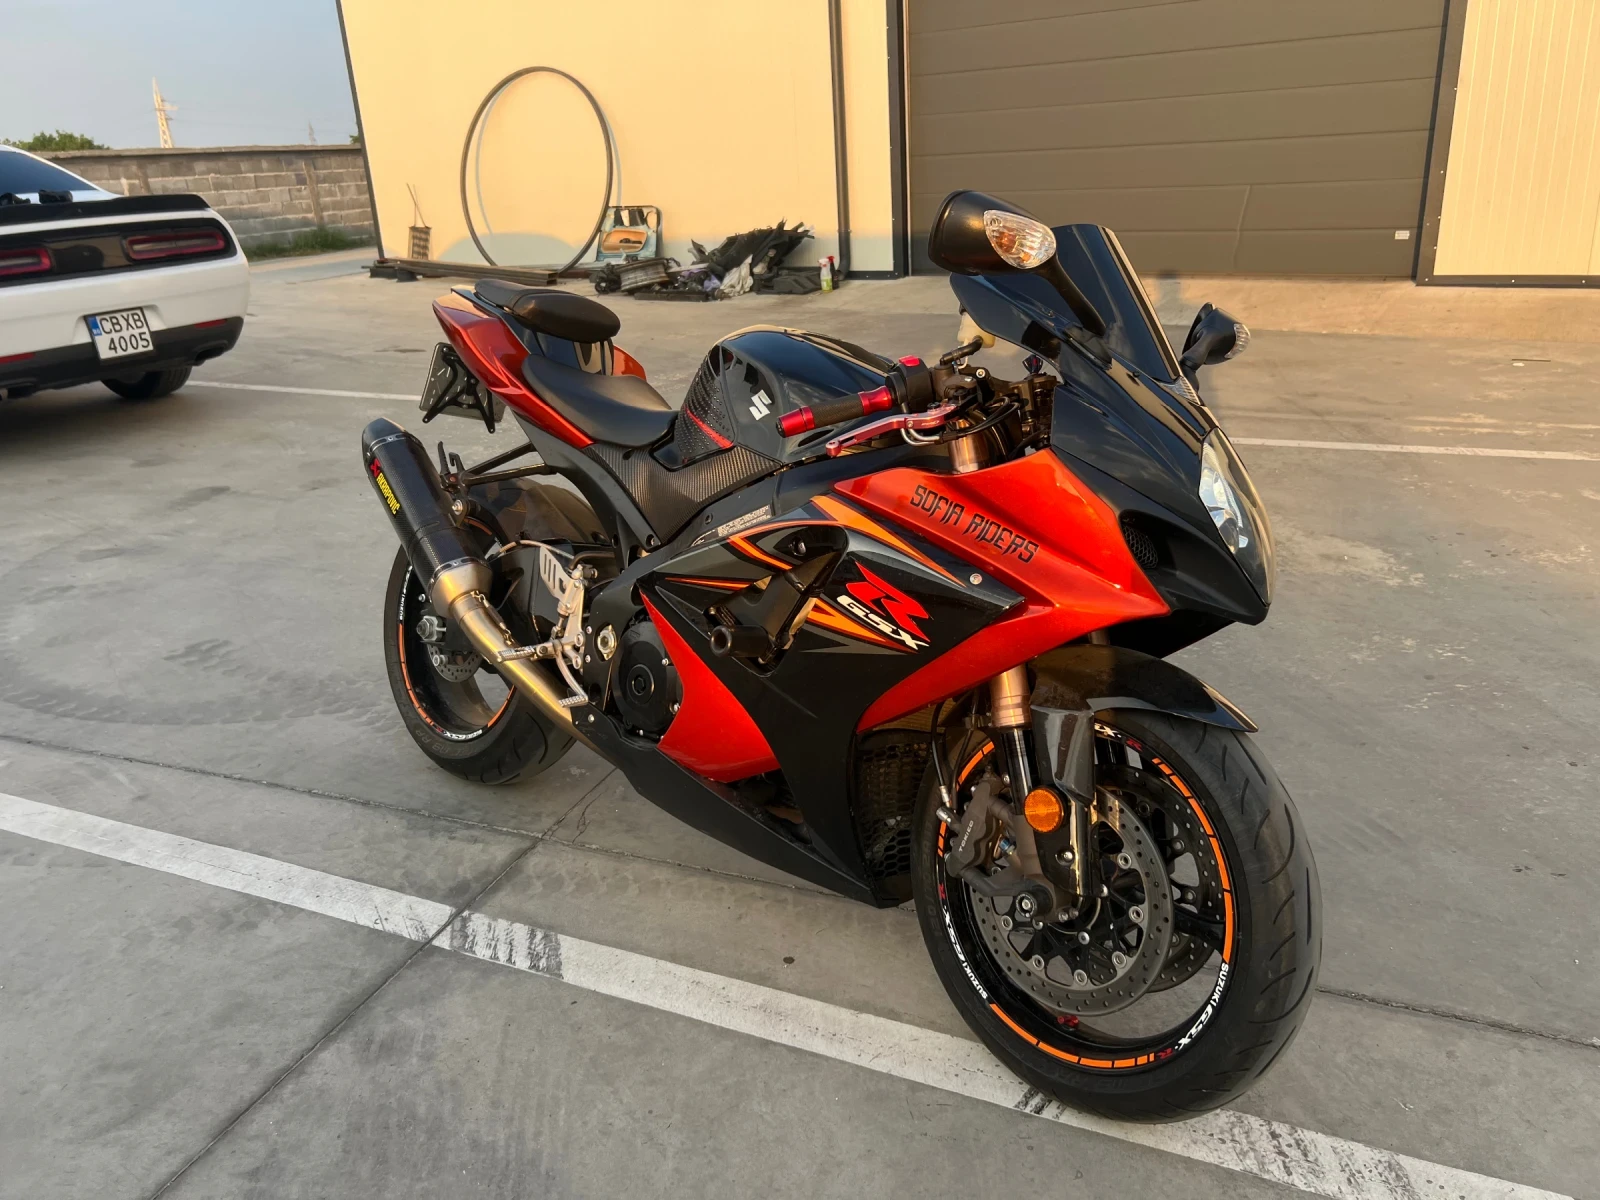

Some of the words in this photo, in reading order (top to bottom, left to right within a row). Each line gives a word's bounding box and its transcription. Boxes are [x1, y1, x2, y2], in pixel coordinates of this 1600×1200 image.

[108, 332, 150, 354] 4005
[909, 484, 965, 526] SOFIA
[962, 512, 1039, 563] RIDERS
[836, 594, 930, 650] GSX
[958, 820, 974, 852] TOKICO
[961, 961, 988, 1000] SUZUKI
[1209, 962, 1229, 1007] SUZUKI
